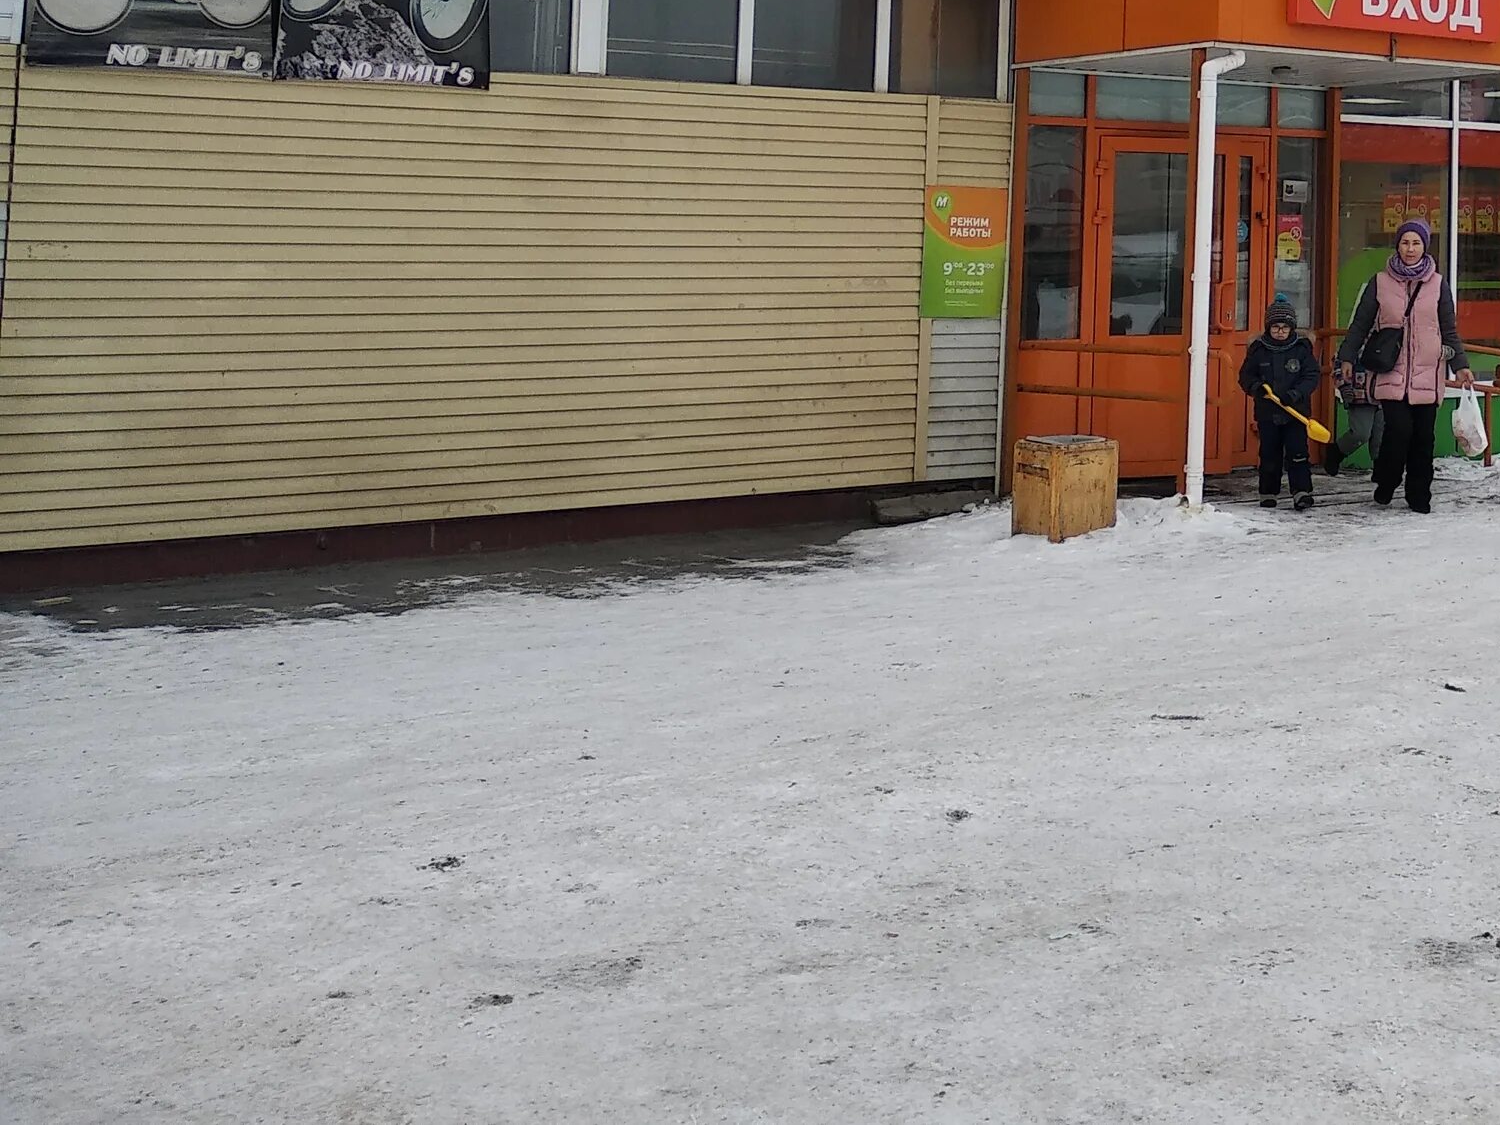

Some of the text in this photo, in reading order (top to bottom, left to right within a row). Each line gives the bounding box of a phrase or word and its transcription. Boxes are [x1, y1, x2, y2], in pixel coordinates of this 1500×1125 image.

[105, 43, 150, 66] NO
[337, 60, 373, 81] NO
[950, 216, 990, 227] РЕЖИМ
[949, 227, 992, 238] РАБОТЫ
